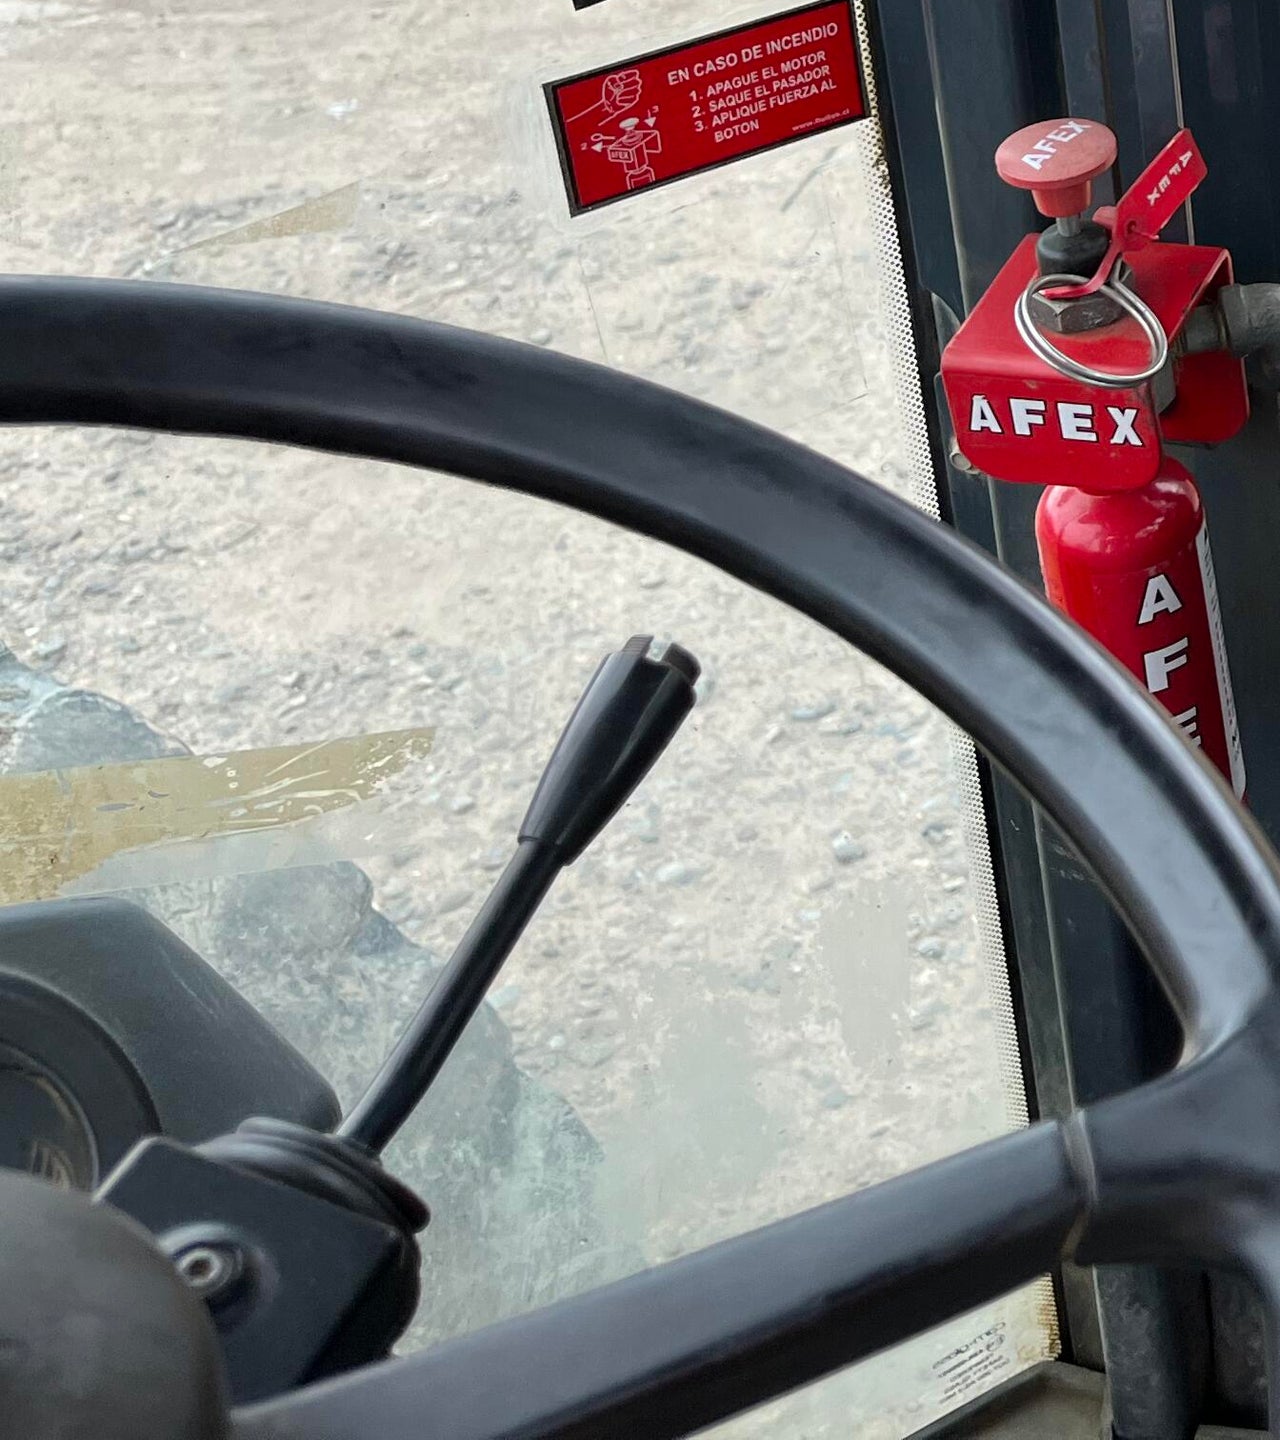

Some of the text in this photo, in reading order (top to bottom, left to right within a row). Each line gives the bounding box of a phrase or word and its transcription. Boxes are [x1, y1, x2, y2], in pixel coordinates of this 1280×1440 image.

[667, 22, 838, 86] EN CASO DE INCENDIO
[688, 50, 826, 102] 1. APAGUE EL MOTOR
[692, 64, 831, 118] 2. SAQUE EL PASADOR
[711, 100, 767, 128] APLIQUE
[769, 83, 819, 109] FUERZA
[820, 78, 837, 93] AL
[714, 119, 760, 143] BOTON
[1021, 119, 1091, 170] AFEX
[1145, 149, 1194, 208] AFEX
[969, 394, 1144, 448] AFEX
